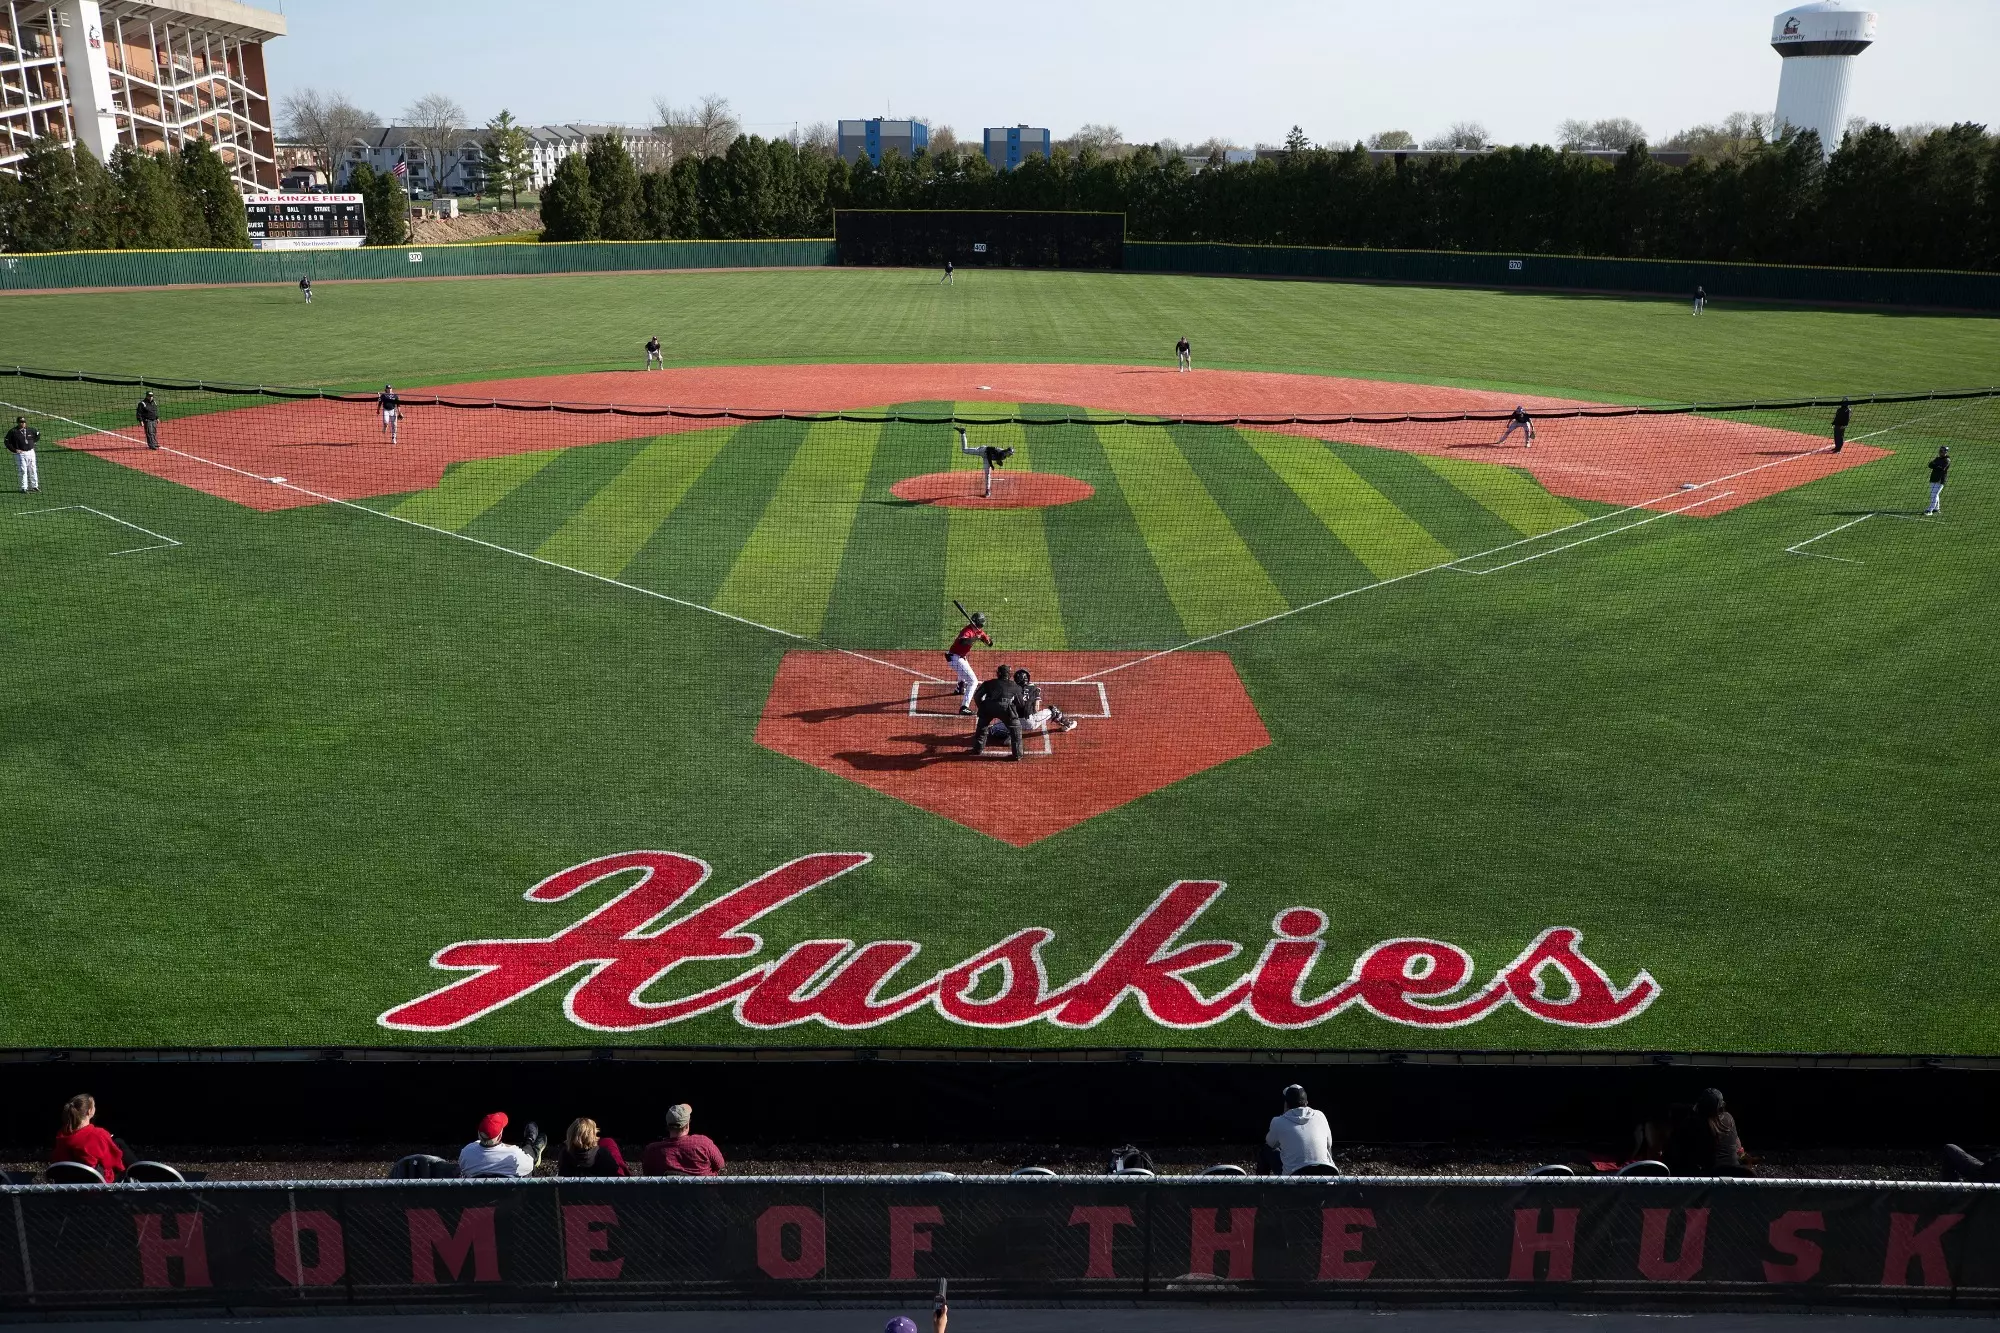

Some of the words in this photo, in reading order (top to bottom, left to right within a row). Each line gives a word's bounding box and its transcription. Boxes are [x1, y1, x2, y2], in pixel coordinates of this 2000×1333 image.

[409, 253, 422, 261] 370
[1509, 261, 1522, 269] 370
[376, 849, 1663, 1032] Huskies
[134, 1204, 627, 1288] HOME
[756, 1204, 946, 1281] OF
[1067, 1206, 1379, 1282] THE
[1508, 1207, 1966, 1288] HUSK
